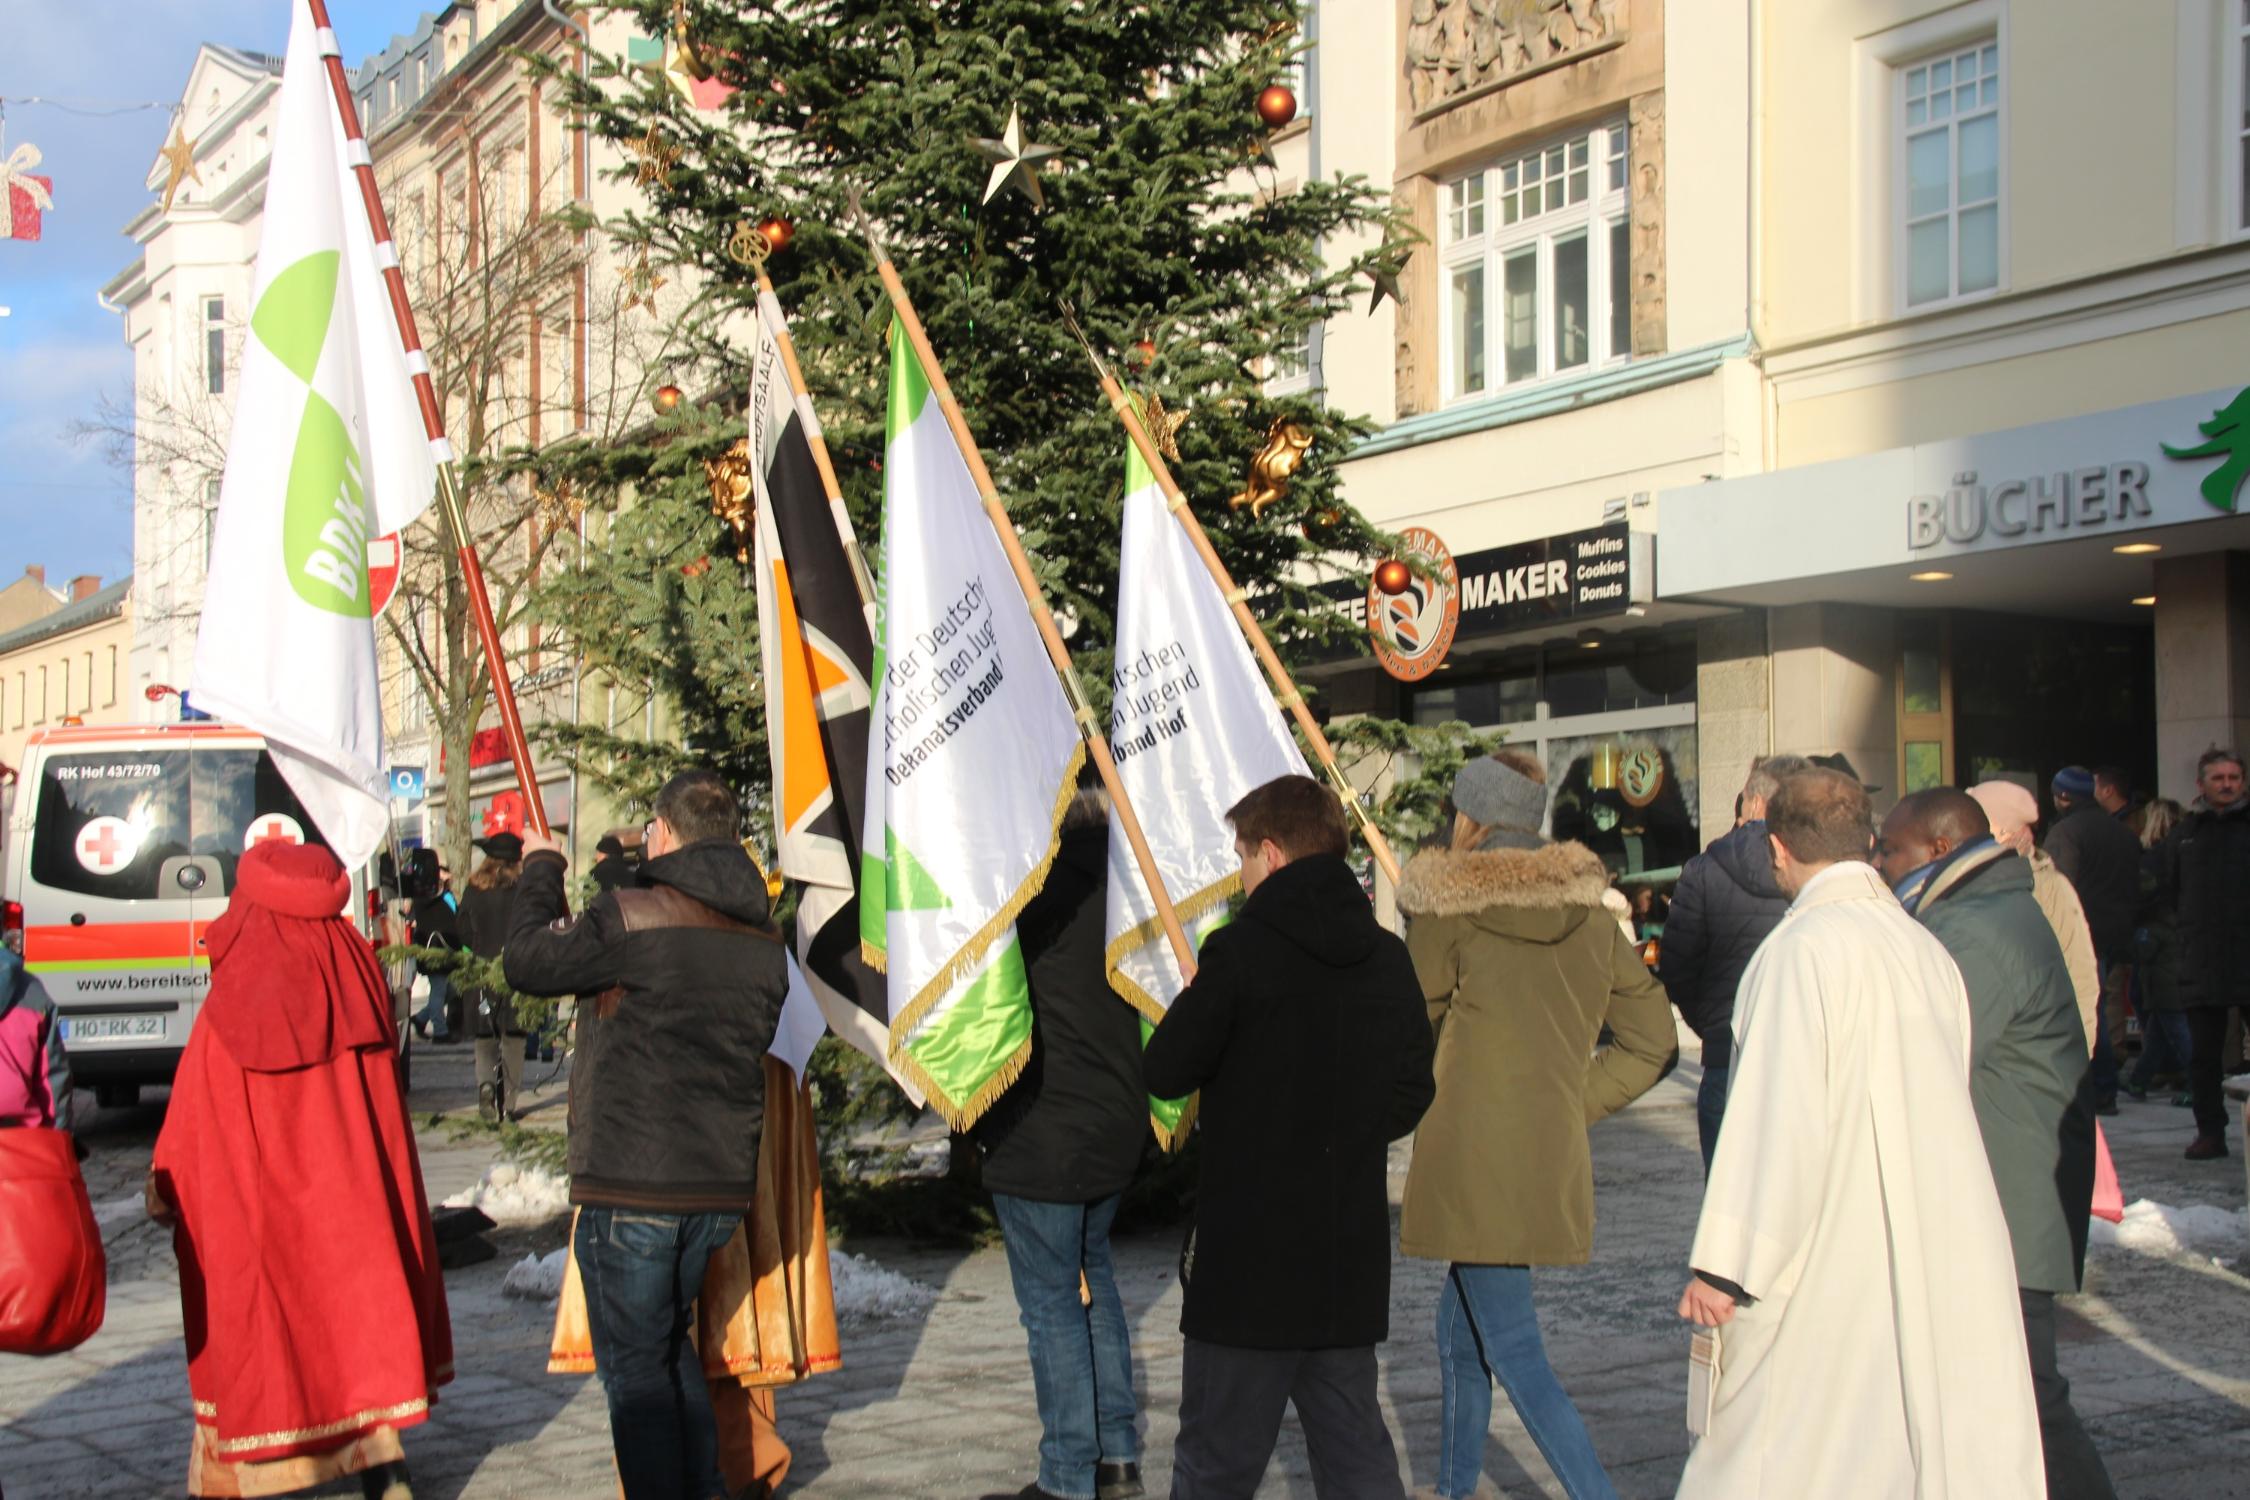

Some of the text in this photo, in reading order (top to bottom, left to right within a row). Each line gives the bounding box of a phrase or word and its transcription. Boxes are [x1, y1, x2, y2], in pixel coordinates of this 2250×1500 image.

[1907, 461, 2152, 550] BÜCHER
[1577, 537, 1624, 559] Muffins
[1461, 559, 1569, 612] MAKER
[1576, 560, 1626, 582] Cookies
[1579, 582, 1623, 603] Donuts
[916, 574, 985, 656] Deutsch
[1126, 664, 1200, 720] Jugend
[885, 657, 1004, 787] Dekanatsverband
[1155, 705, 1188, 740] Hof
[58, 767, 78, 780] RK
[81, 766, 105, 779] Hof
[136, 1019, 157, 1034] 32
